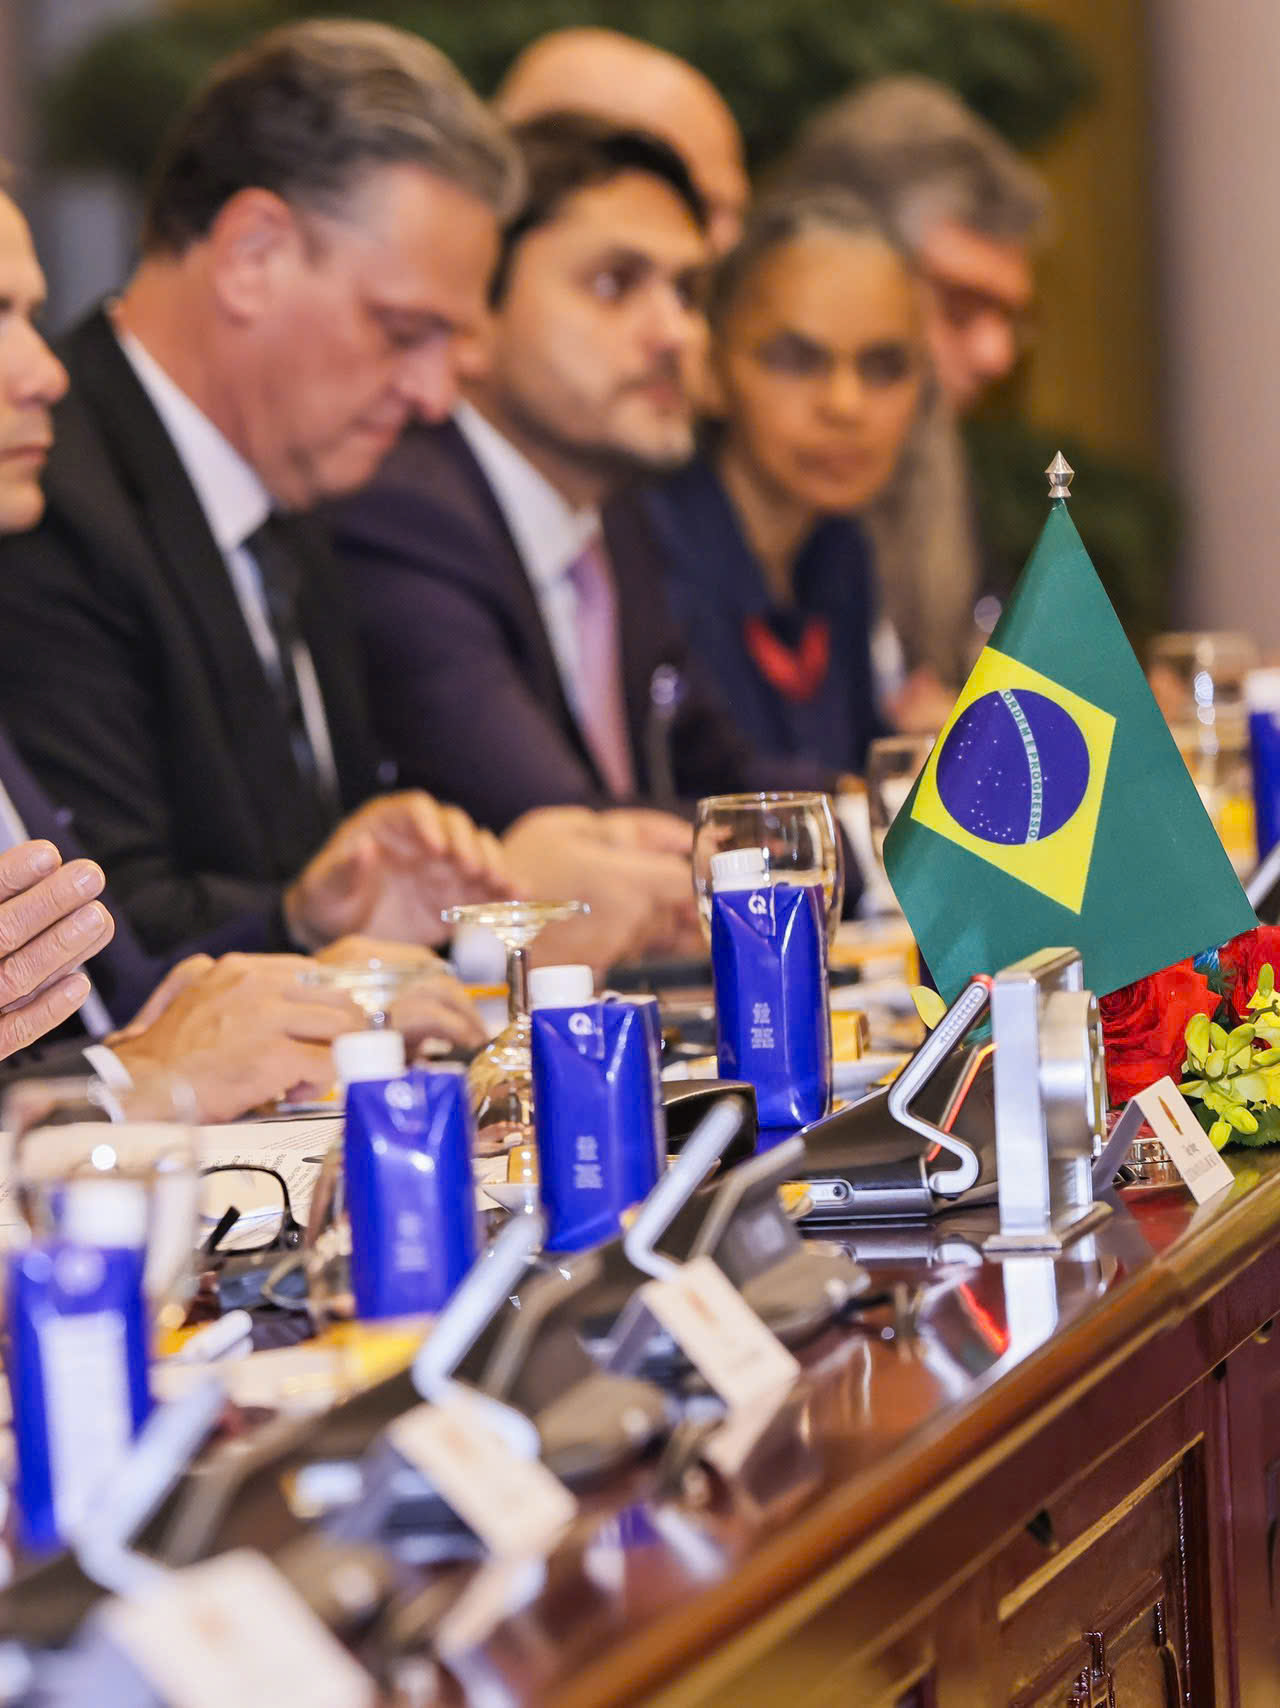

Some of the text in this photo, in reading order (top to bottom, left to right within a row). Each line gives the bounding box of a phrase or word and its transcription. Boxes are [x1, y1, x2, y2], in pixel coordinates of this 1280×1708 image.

[1003, 691, 1031, 737] ORDEM
[1028, 751, 1042, 839] PROGRESSO
[748, 895, 767, 915] Q
